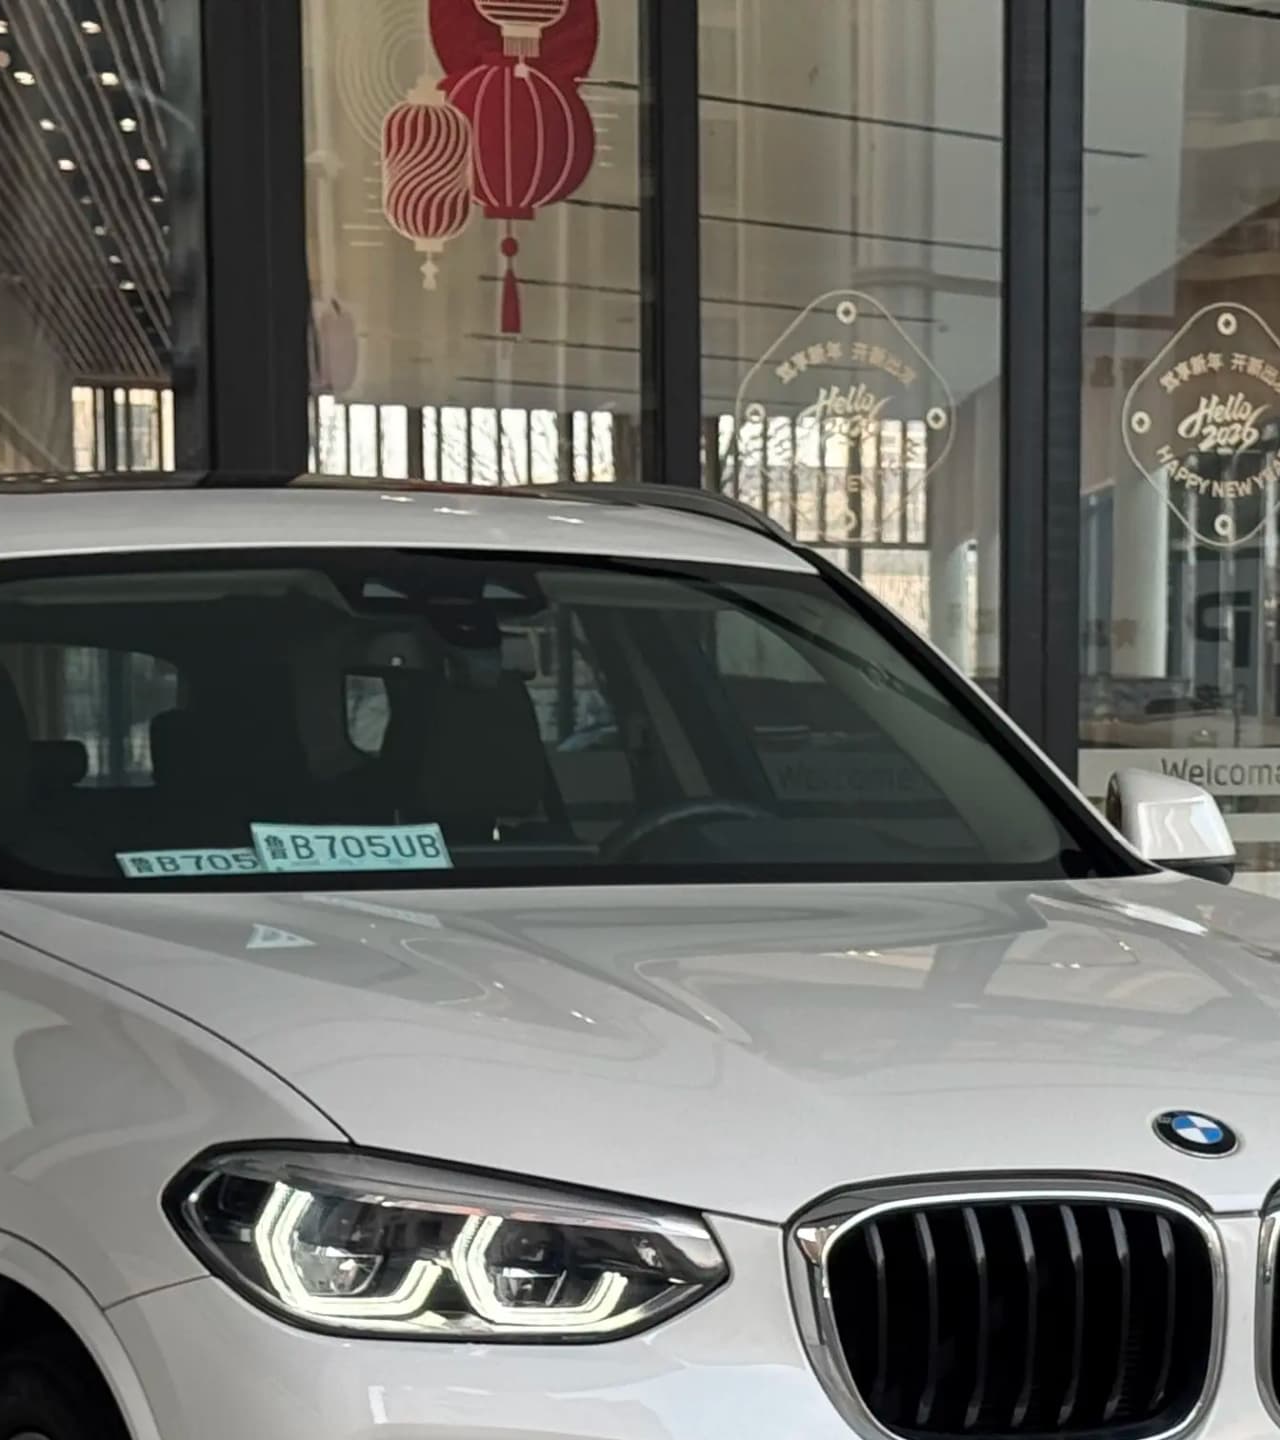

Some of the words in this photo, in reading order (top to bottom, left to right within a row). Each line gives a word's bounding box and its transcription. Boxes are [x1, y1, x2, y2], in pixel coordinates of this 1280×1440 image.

[1177, 392, 1252, 438] Hello
[1198, 404, 1271, 452] 2026
[1156, 445, 1211, 494] HAPPY
[1212, 477, 1253, 498] NEW
